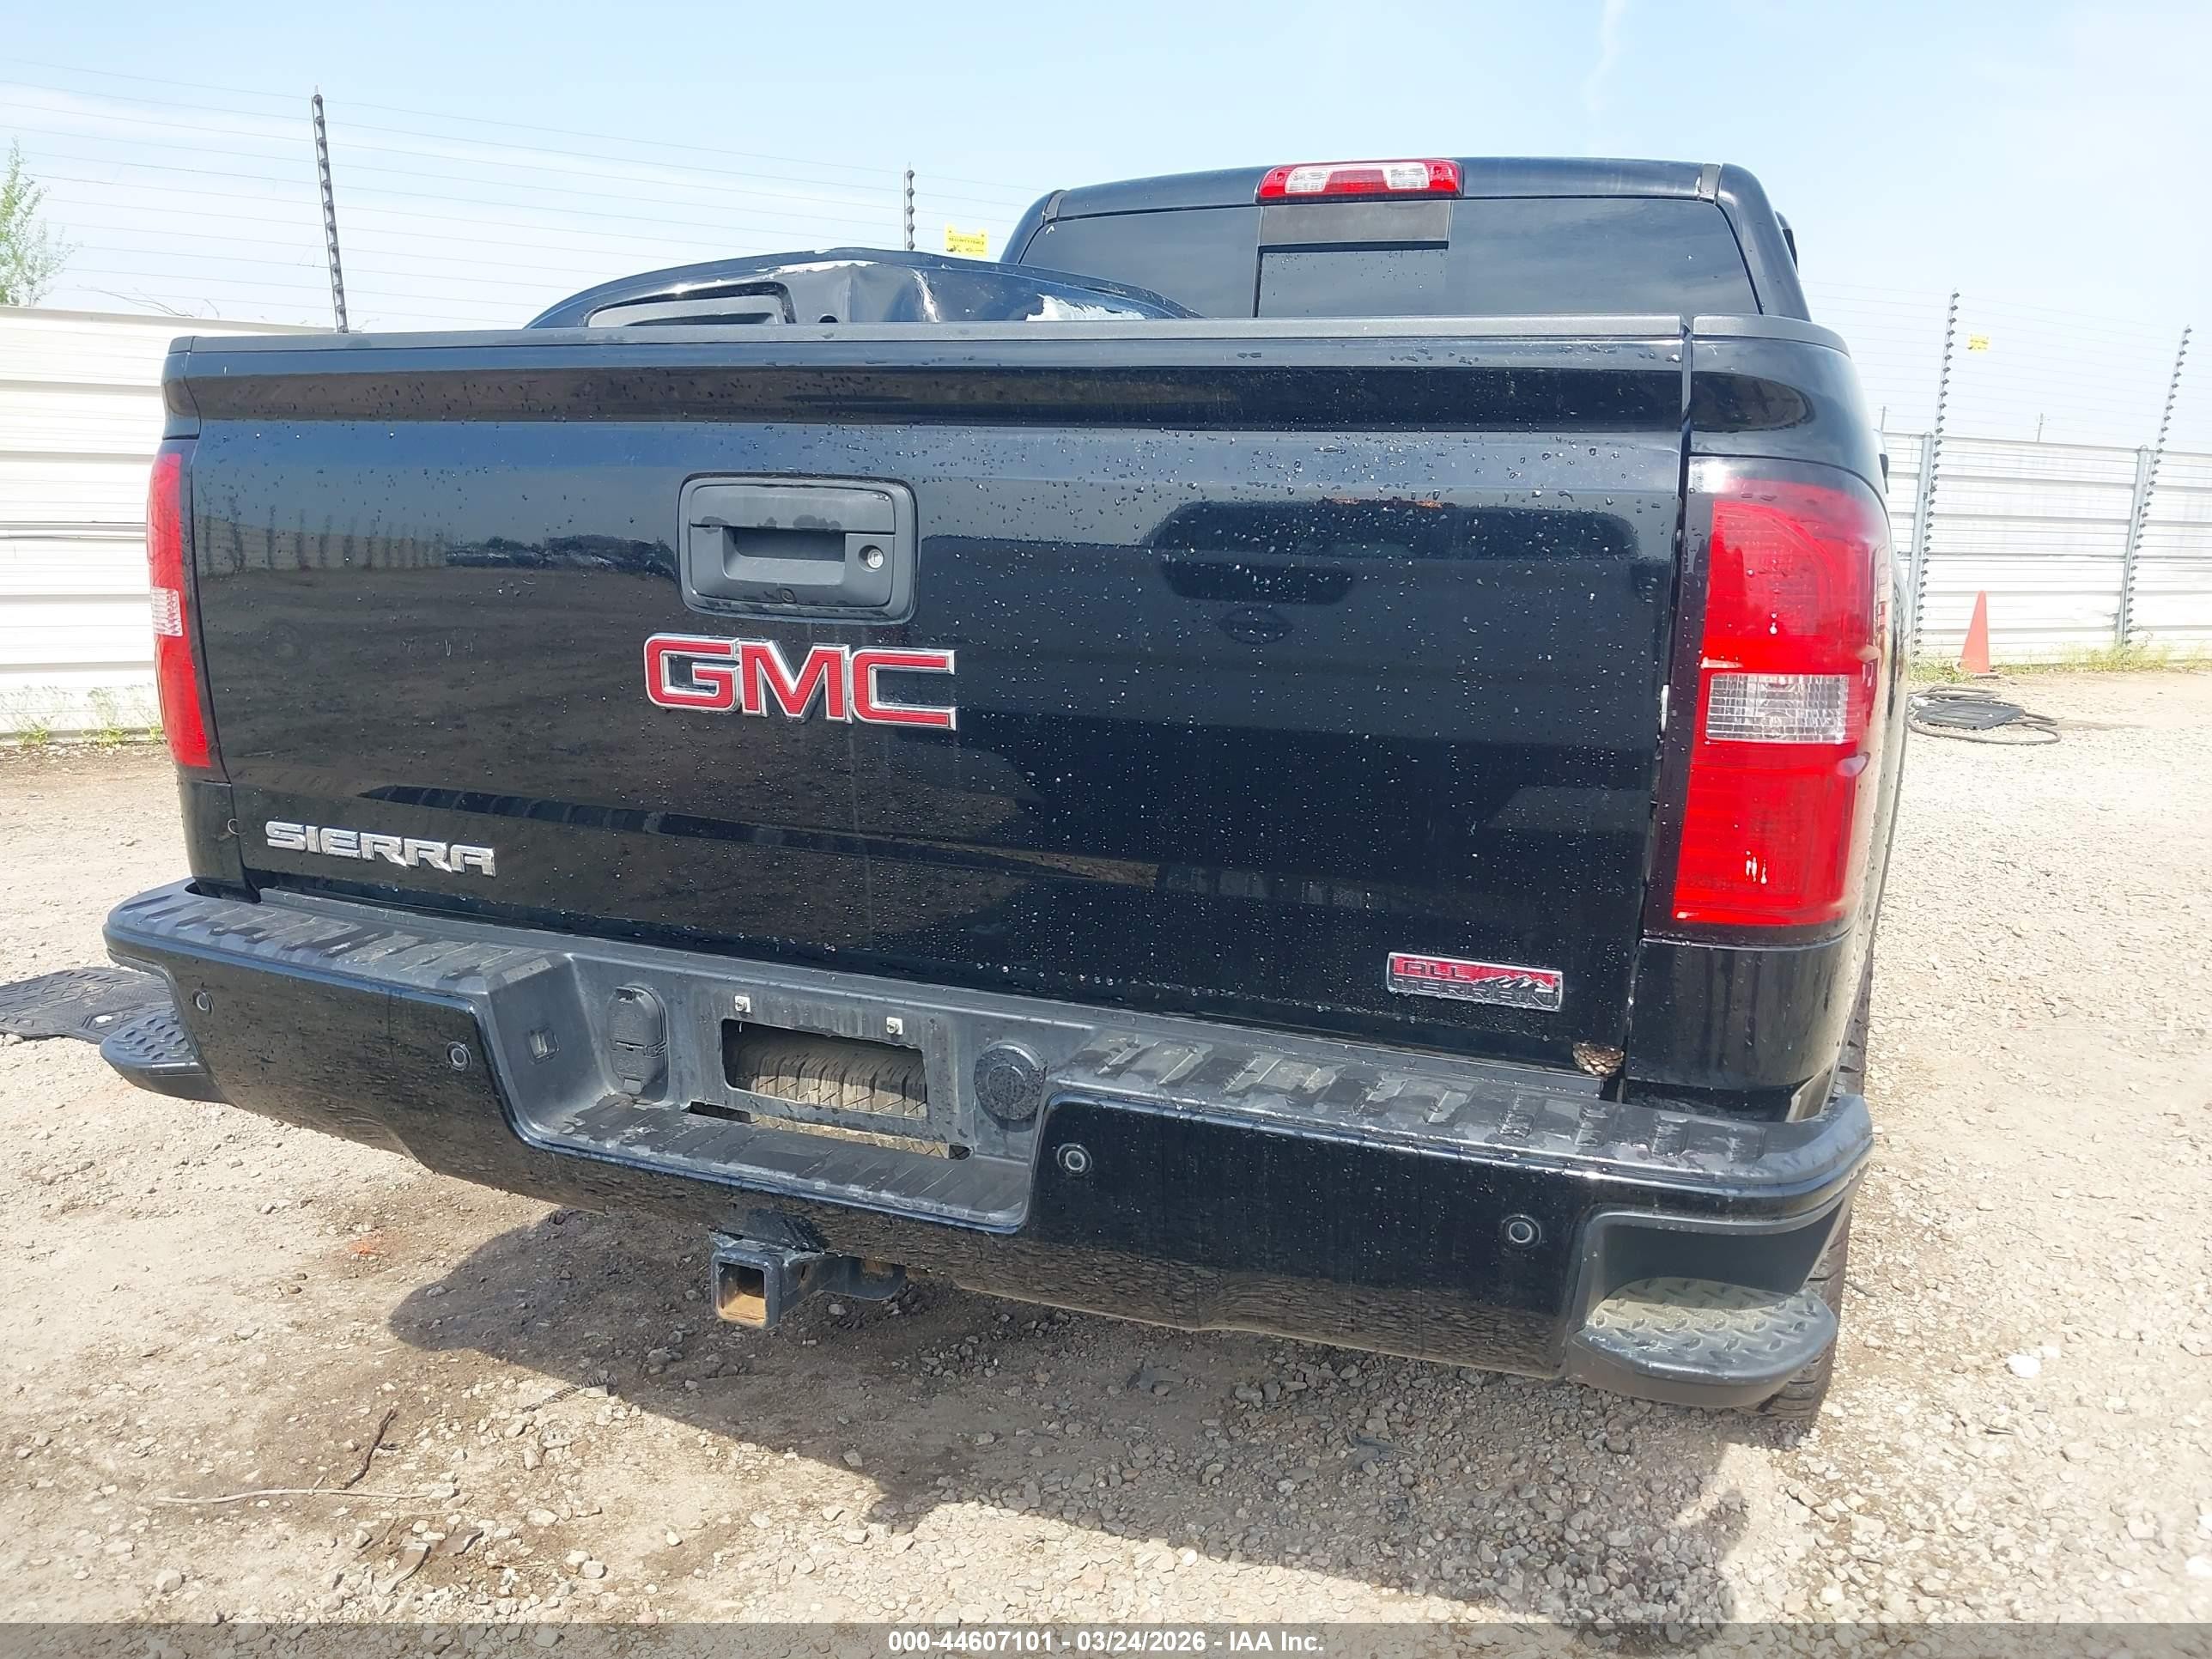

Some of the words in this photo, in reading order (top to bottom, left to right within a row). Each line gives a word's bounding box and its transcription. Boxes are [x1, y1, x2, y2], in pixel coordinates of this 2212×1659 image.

[643, 632, 957, 732] GMC
[264, 820, 496, 878] SIERRA
[1402, 959, 1470, 979] ALL
